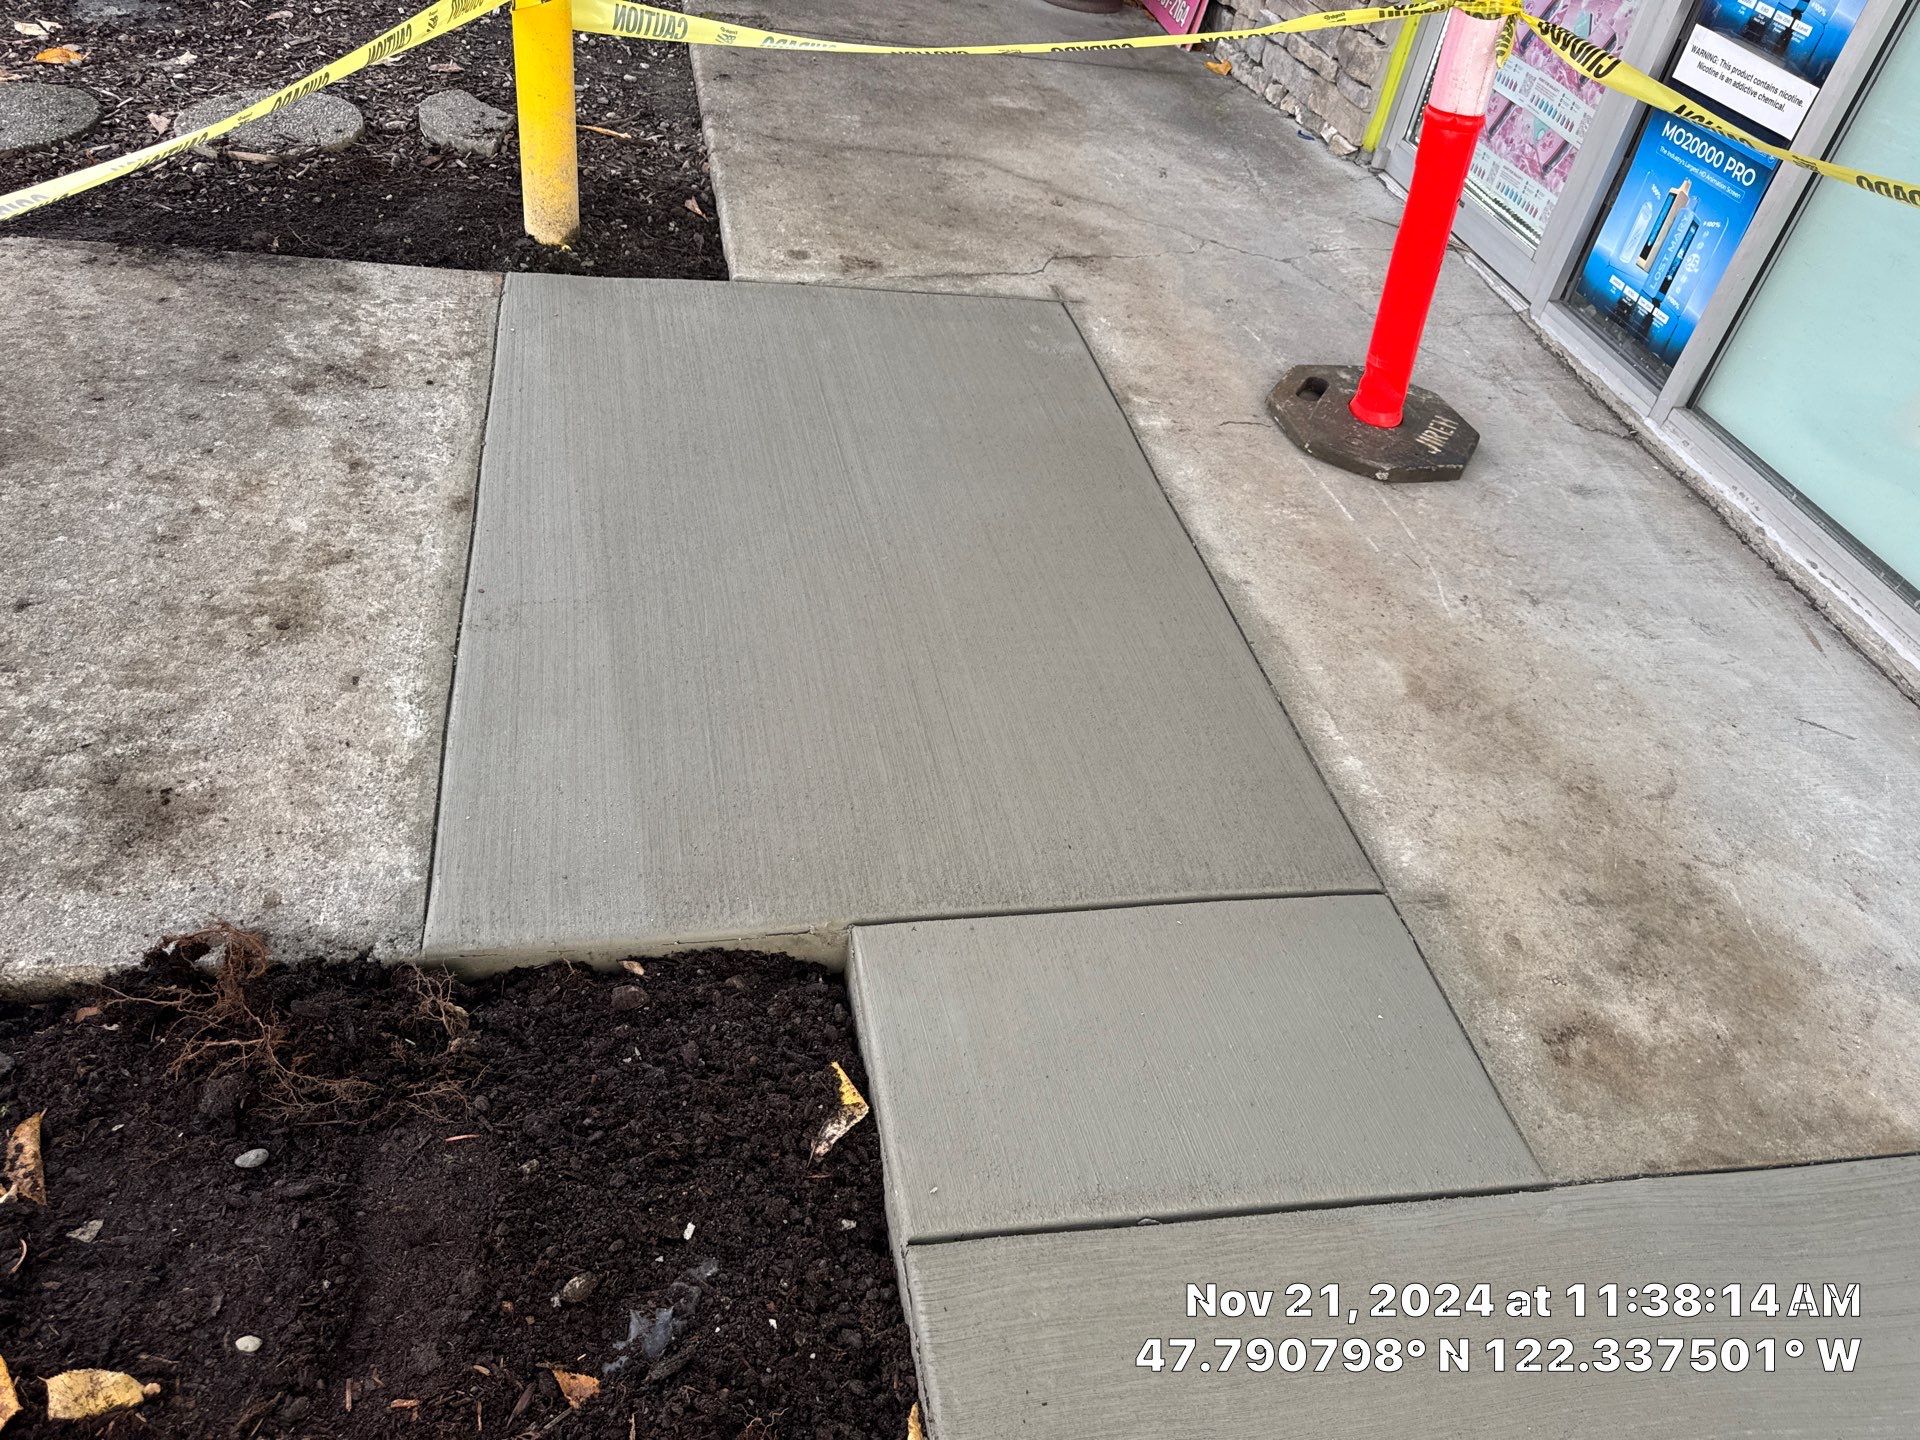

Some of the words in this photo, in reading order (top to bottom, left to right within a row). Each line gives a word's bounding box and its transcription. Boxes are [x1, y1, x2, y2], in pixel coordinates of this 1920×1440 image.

[1537, 20, 1622, 79] CUIDADO
[1690, 44, 1719, 64] WARNING:
[1719, 58, 1732, 71] This
[1731, 65, 1754, 82] product
[1753, 76, 1779, 95] contains
[1778, 89, 1804, 108] nicotine.
[1696, 60, 1719, 78] Nicotine
[1718, 72, 1724, 81] is
[1724, 76, 1733, 86] an
[1731, 78, 1758, 98] addictive
[1757, 92, 1785, 113] chemical.
[1661, 120, 1725, 169] MO20000
[1723, 156, 1757, 187] PRO
[1649, 253, 1669, 290] LOST
[1667, 213, 1690, 253] MARY
